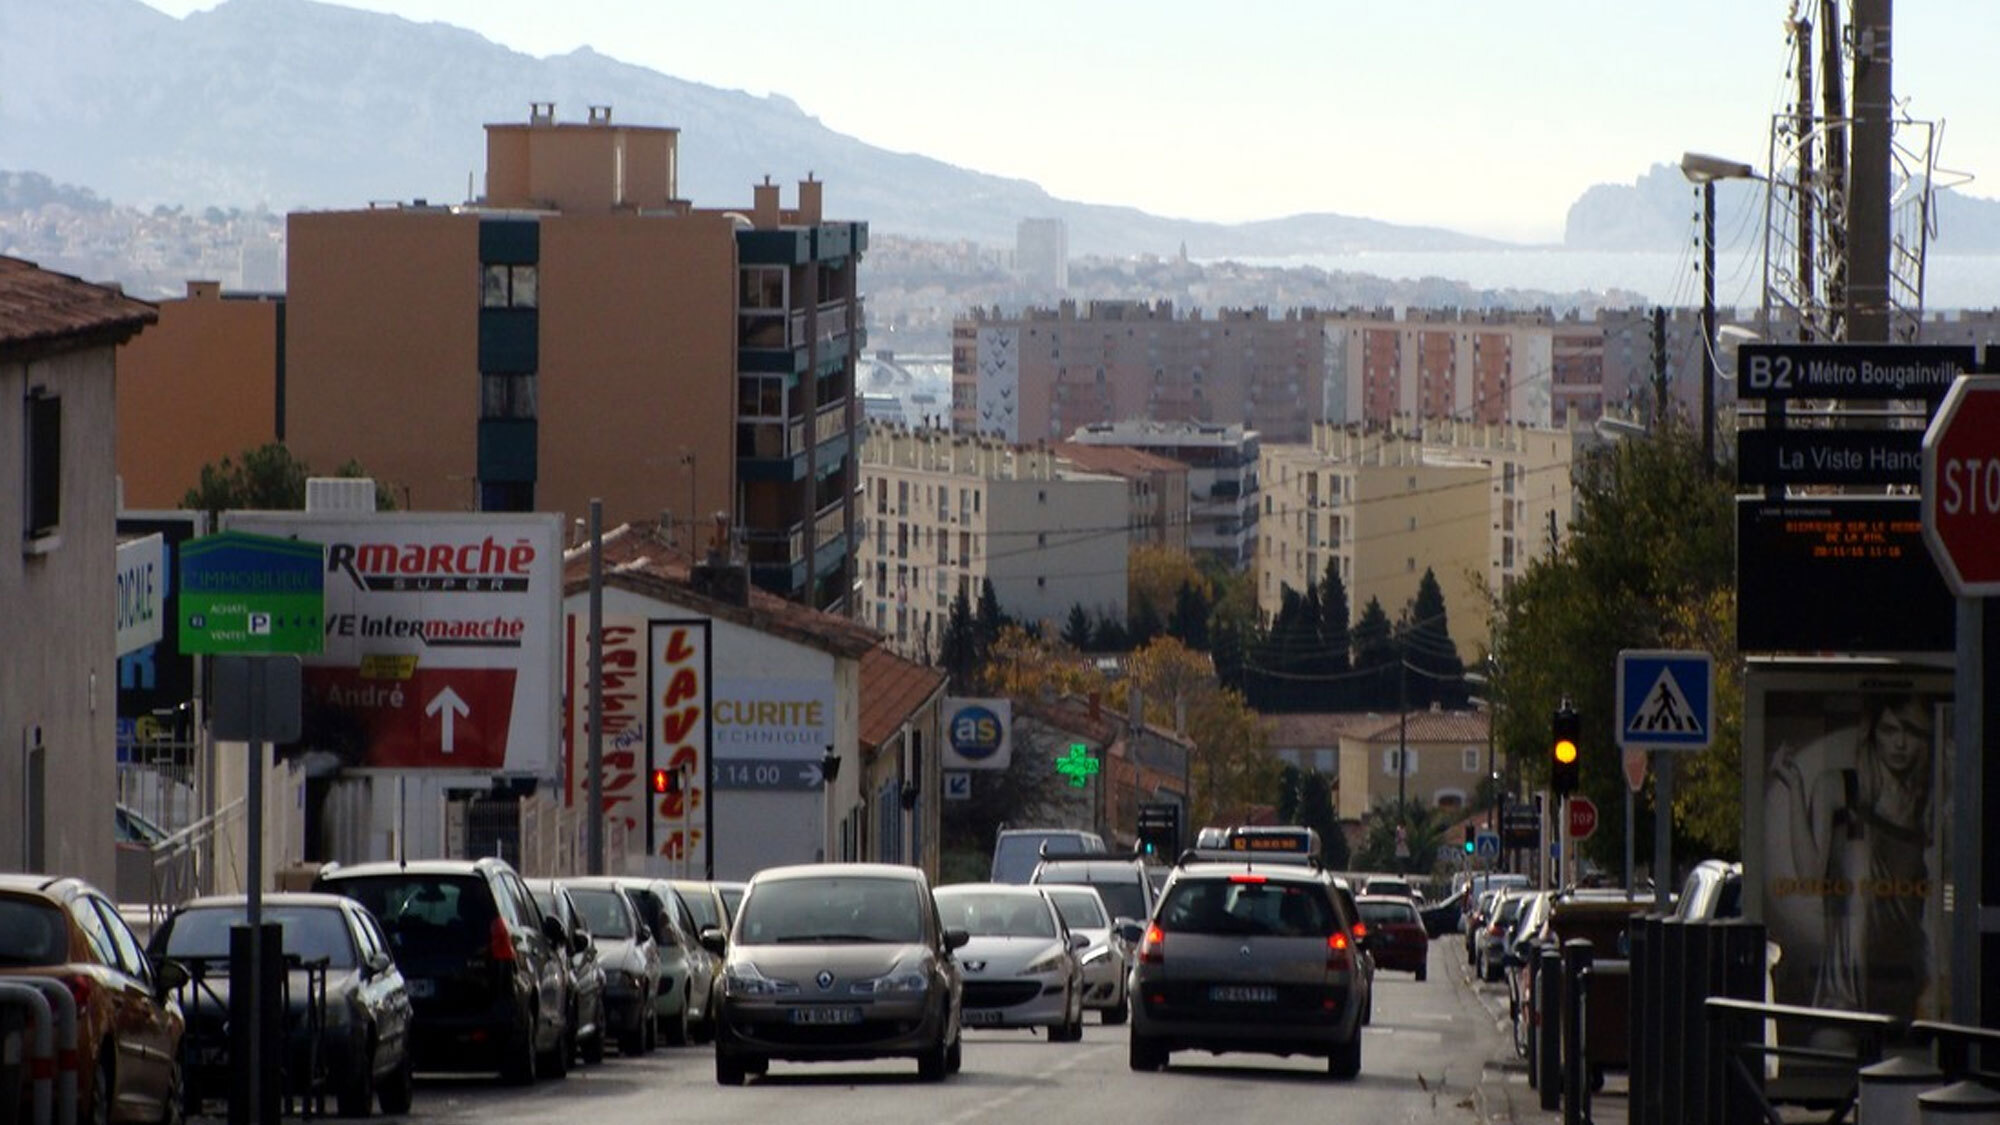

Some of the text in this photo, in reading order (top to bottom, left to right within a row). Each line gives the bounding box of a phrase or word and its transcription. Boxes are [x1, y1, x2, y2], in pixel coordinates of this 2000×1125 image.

[1750, 355, 1792, 388] B2
[1810, 360, 1856, 384] Métro
[1780, 447, 1804, 470] La
[1811, 447, 1863, 470] Viste
[1943, 457, 2000, 515] STO
[328, 682, 404, 708] André
[956, 717, 996, 742] as
[728, 765, 748, 783] 14
[755, 765, 780, 784] 00
[1573, 811, 1592, 825] TOP
